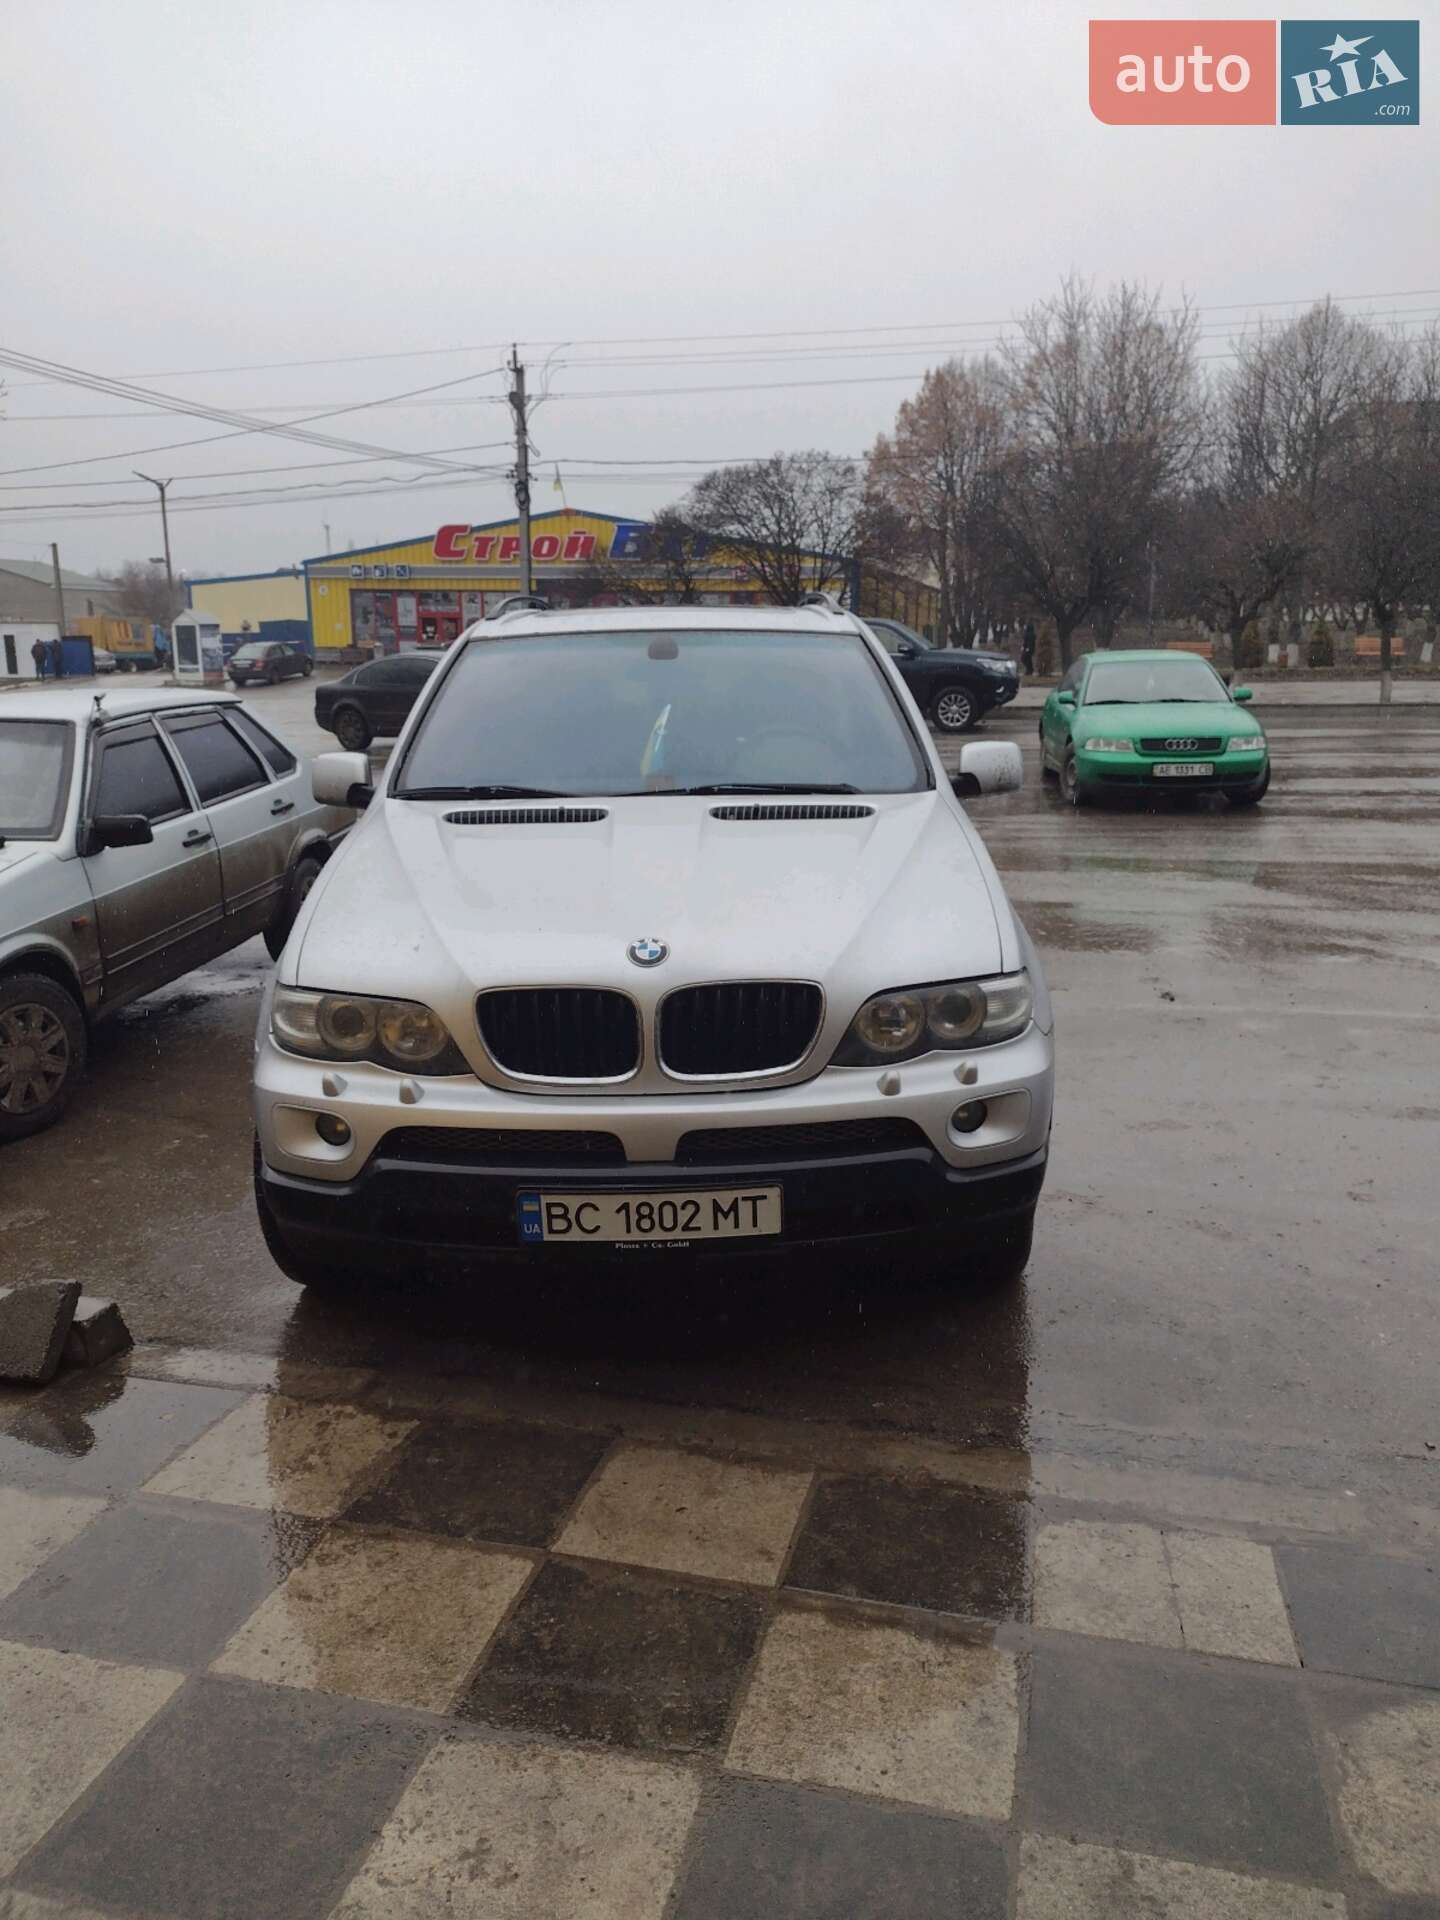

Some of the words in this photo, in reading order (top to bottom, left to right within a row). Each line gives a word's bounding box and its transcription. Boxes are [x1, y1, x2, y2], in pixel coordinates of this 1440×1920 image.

[546, 1202, 600, 1234] BC
[615, 1200, 701, 1234] 1802
[712, 1194, 767, 1231] MT
[523, 1223, 541, 1234] UA
